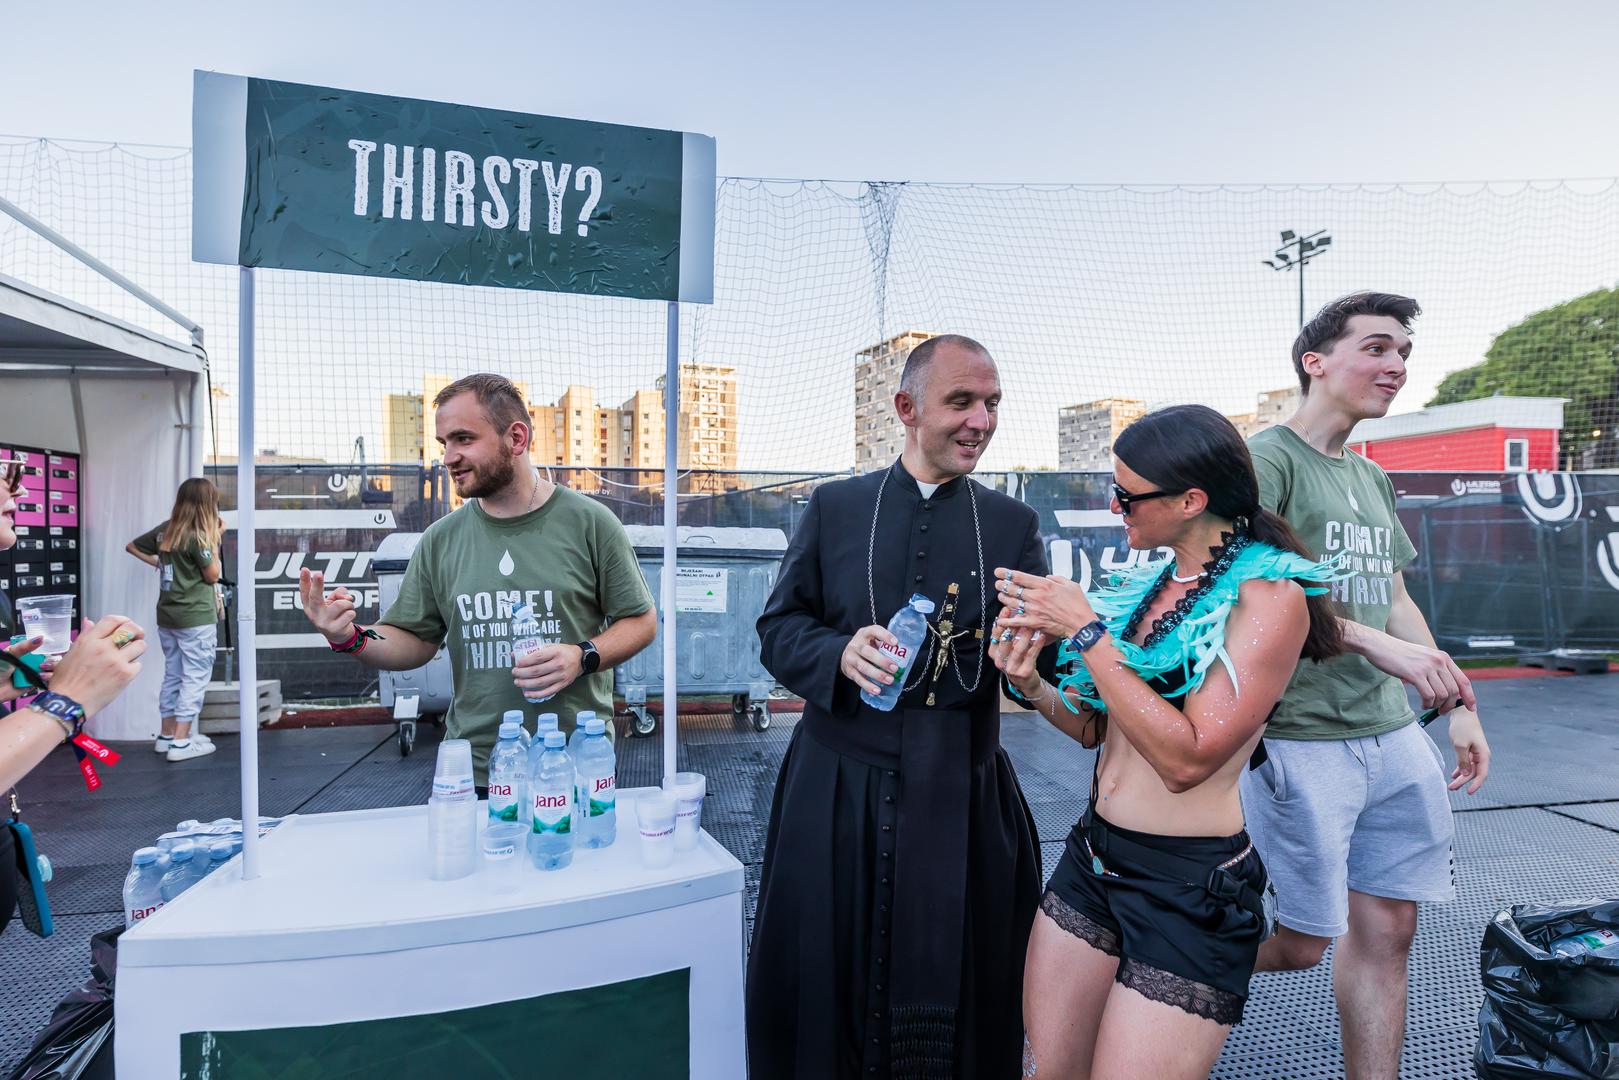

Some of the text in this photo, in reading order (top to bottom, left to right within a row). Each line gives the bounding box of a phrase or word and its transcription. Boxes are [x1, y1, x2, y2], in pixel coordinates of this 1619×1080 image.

[347, 138, 603, 237] THIRSTY?
[1325, 521, 1391, 556] COME!
[456, 590, 553, 621] COME!
[472, 623, 486, 638] OF
[489, 622, 508, 637] YOU
[540, 619, 562, 634] ARE
[489, 782, 511, 796] ana
[594, 776, 615, 792] Jan
[535, 794, 567, 808] Jana
